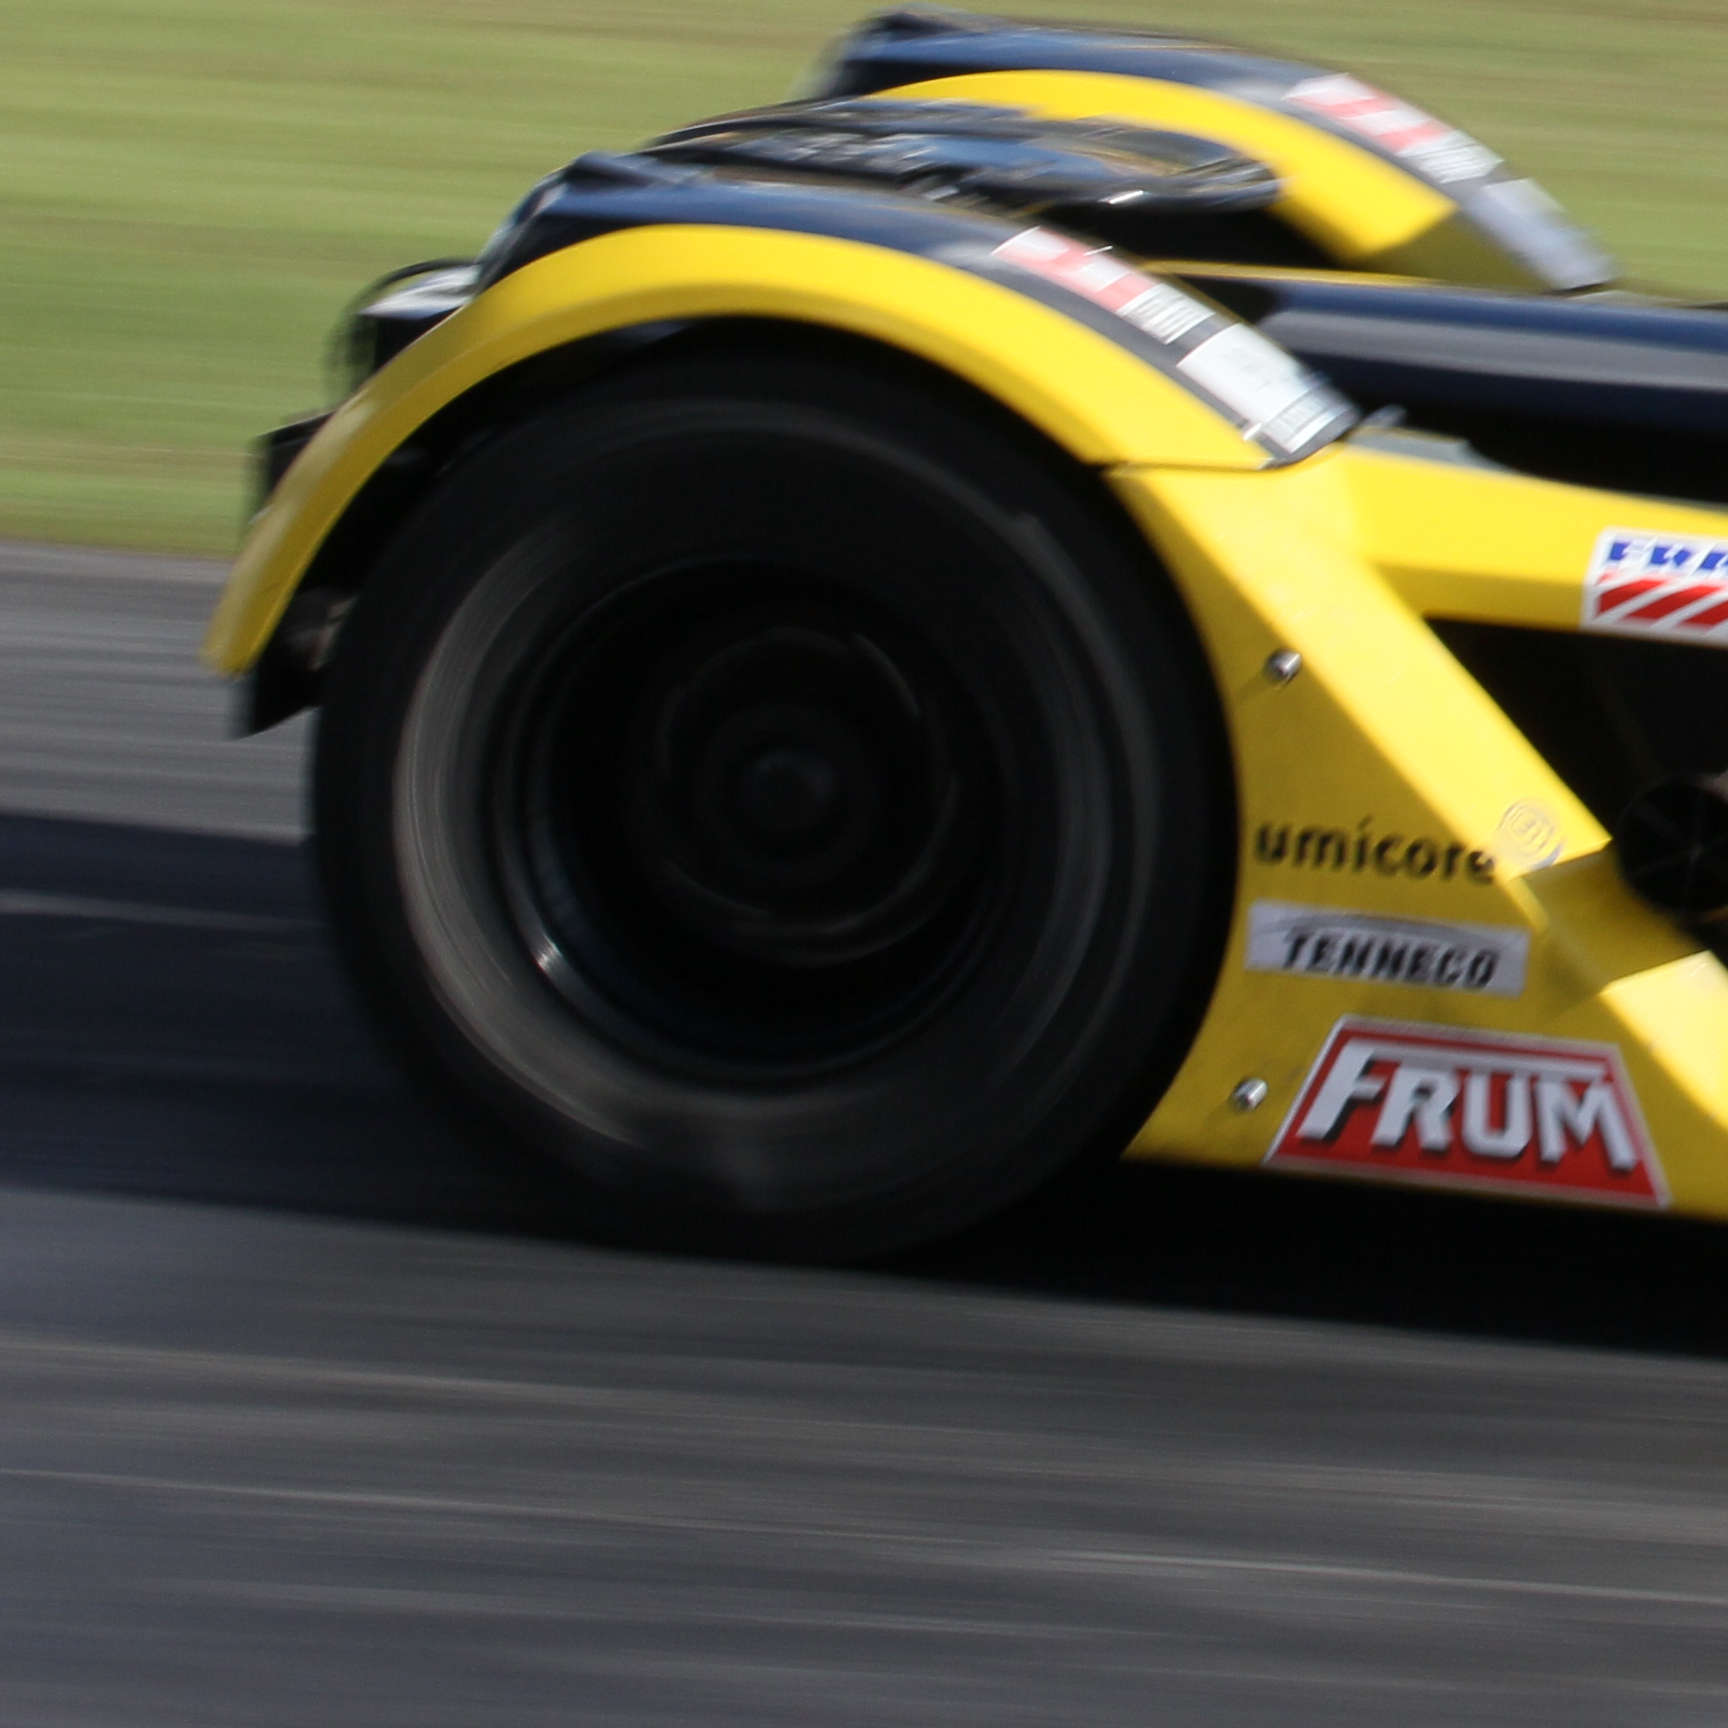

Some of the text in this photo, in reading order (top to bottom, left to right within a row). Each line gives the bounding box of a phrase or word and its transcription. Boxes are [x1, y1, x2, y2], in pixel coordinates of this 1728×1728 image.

[1255, 816, 1496, 885] umicore
[1283, 926, 1500, 990] TENNECO
[1296, 1040, 1638, 1171] FRUM
